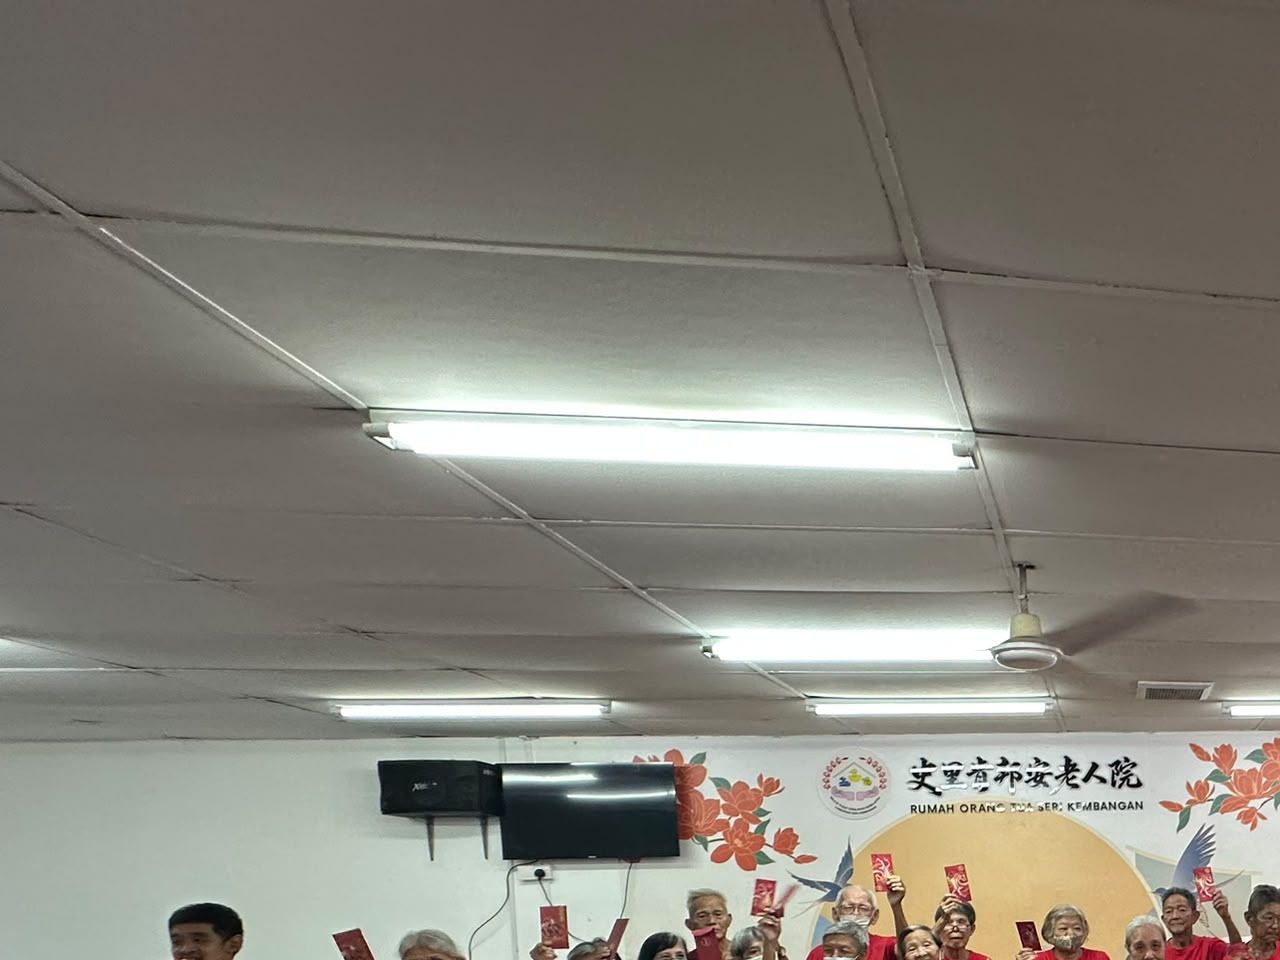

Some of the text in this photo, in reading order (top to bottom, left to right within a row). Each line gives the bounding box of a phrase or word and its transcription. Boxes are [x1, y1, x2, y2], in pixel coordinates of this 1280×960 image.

[910, 803, 955, 814] RUMAH
[1010, 802, 1035, 813] TUA
[1067, 800, 1144, 812] KEMBANGAN
